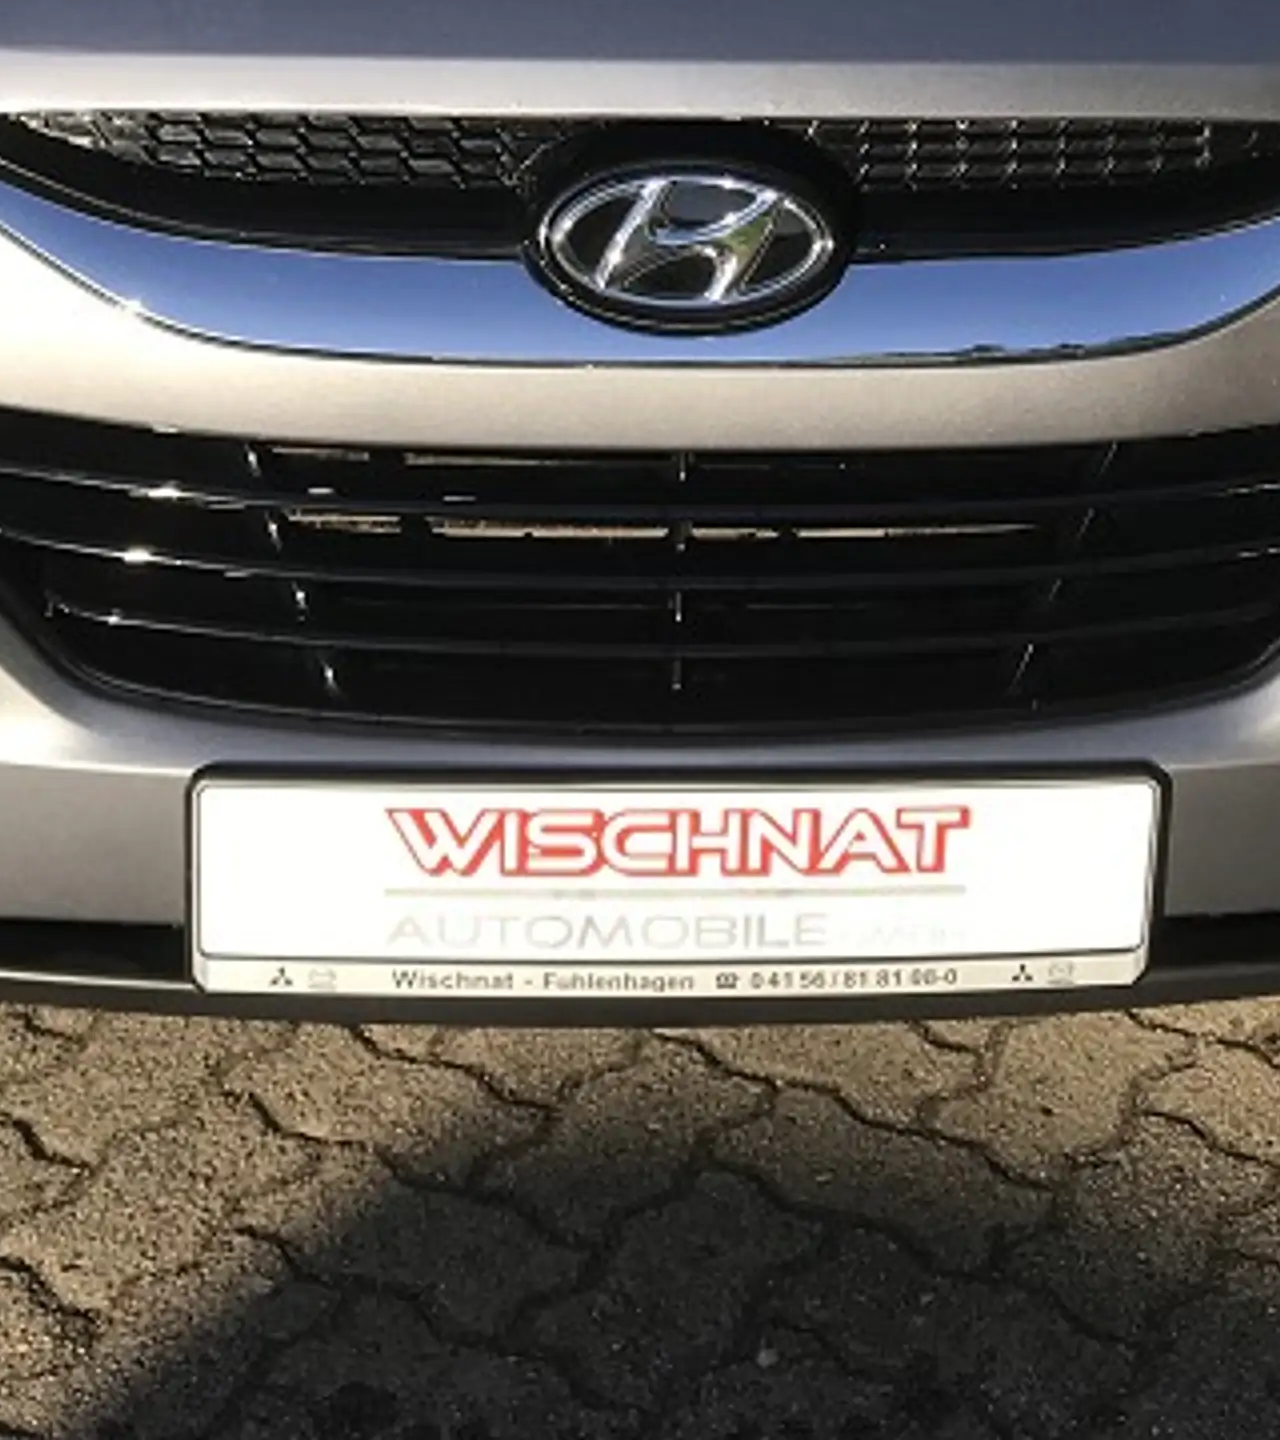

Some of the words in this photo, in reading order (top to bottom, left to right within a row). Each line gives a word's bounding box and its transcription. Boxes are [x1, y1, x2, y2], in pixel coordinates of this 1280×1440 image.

[384, 806, 971, 877] WISCHNAT
[384, 912, 829, 950] AUTOMOBILE
[392, 968, 514, 990] Wischnat
[543, 970, 695, 992] Fuhlenhagen
